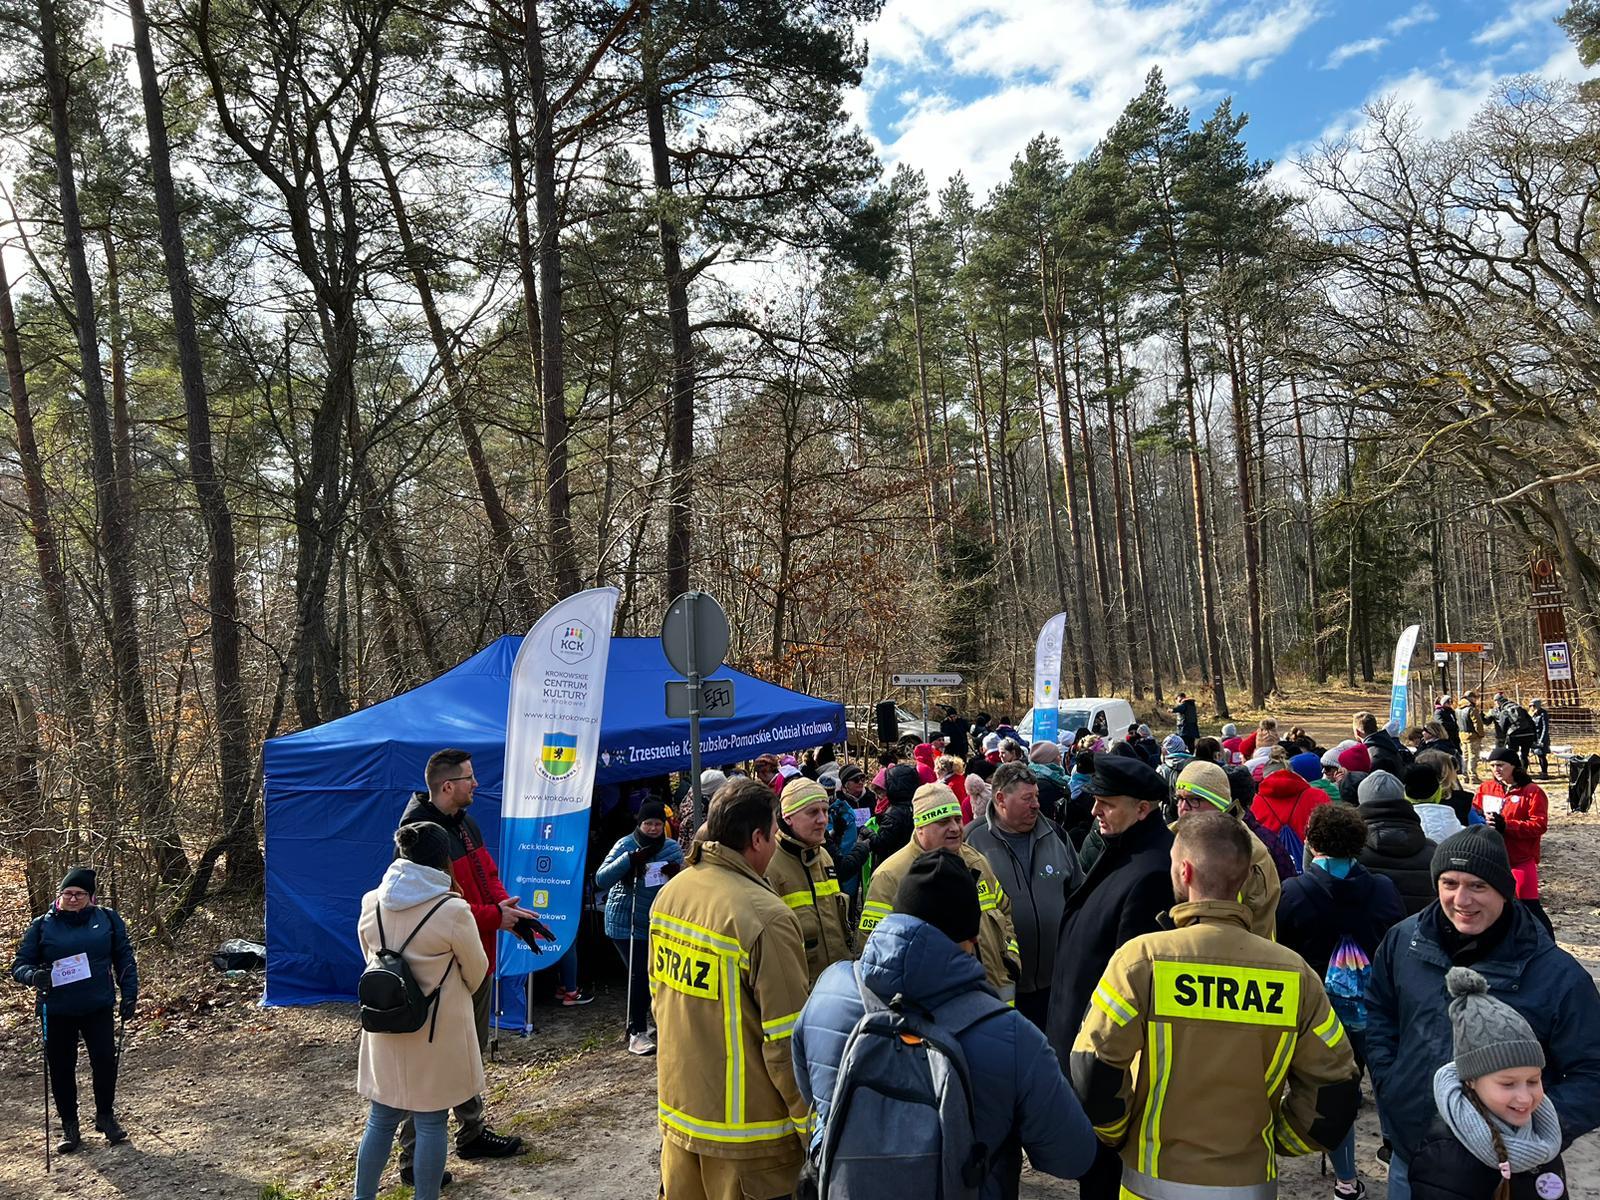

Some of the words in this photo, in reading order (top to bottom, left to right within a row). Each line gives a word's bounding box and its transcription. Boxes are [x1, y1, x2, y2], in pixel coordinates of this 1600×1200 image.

[560, 639, 584, 652] KCK
[545, 670, 589, 680] KROKOWSKIE
[544, 679, 588, 690] CENTRUM
[543, 689, 588, 700] KULTURY
[629, 742, 681, 762] Zrzeszenie
[683, 729, 771, 755] Kazubsko-Pomorskie
[772, 722, 801, 741] Oddział
[801, 721, 833, 736] Krokowa
[523, 794, 584, 804] www.krokowa.pl
